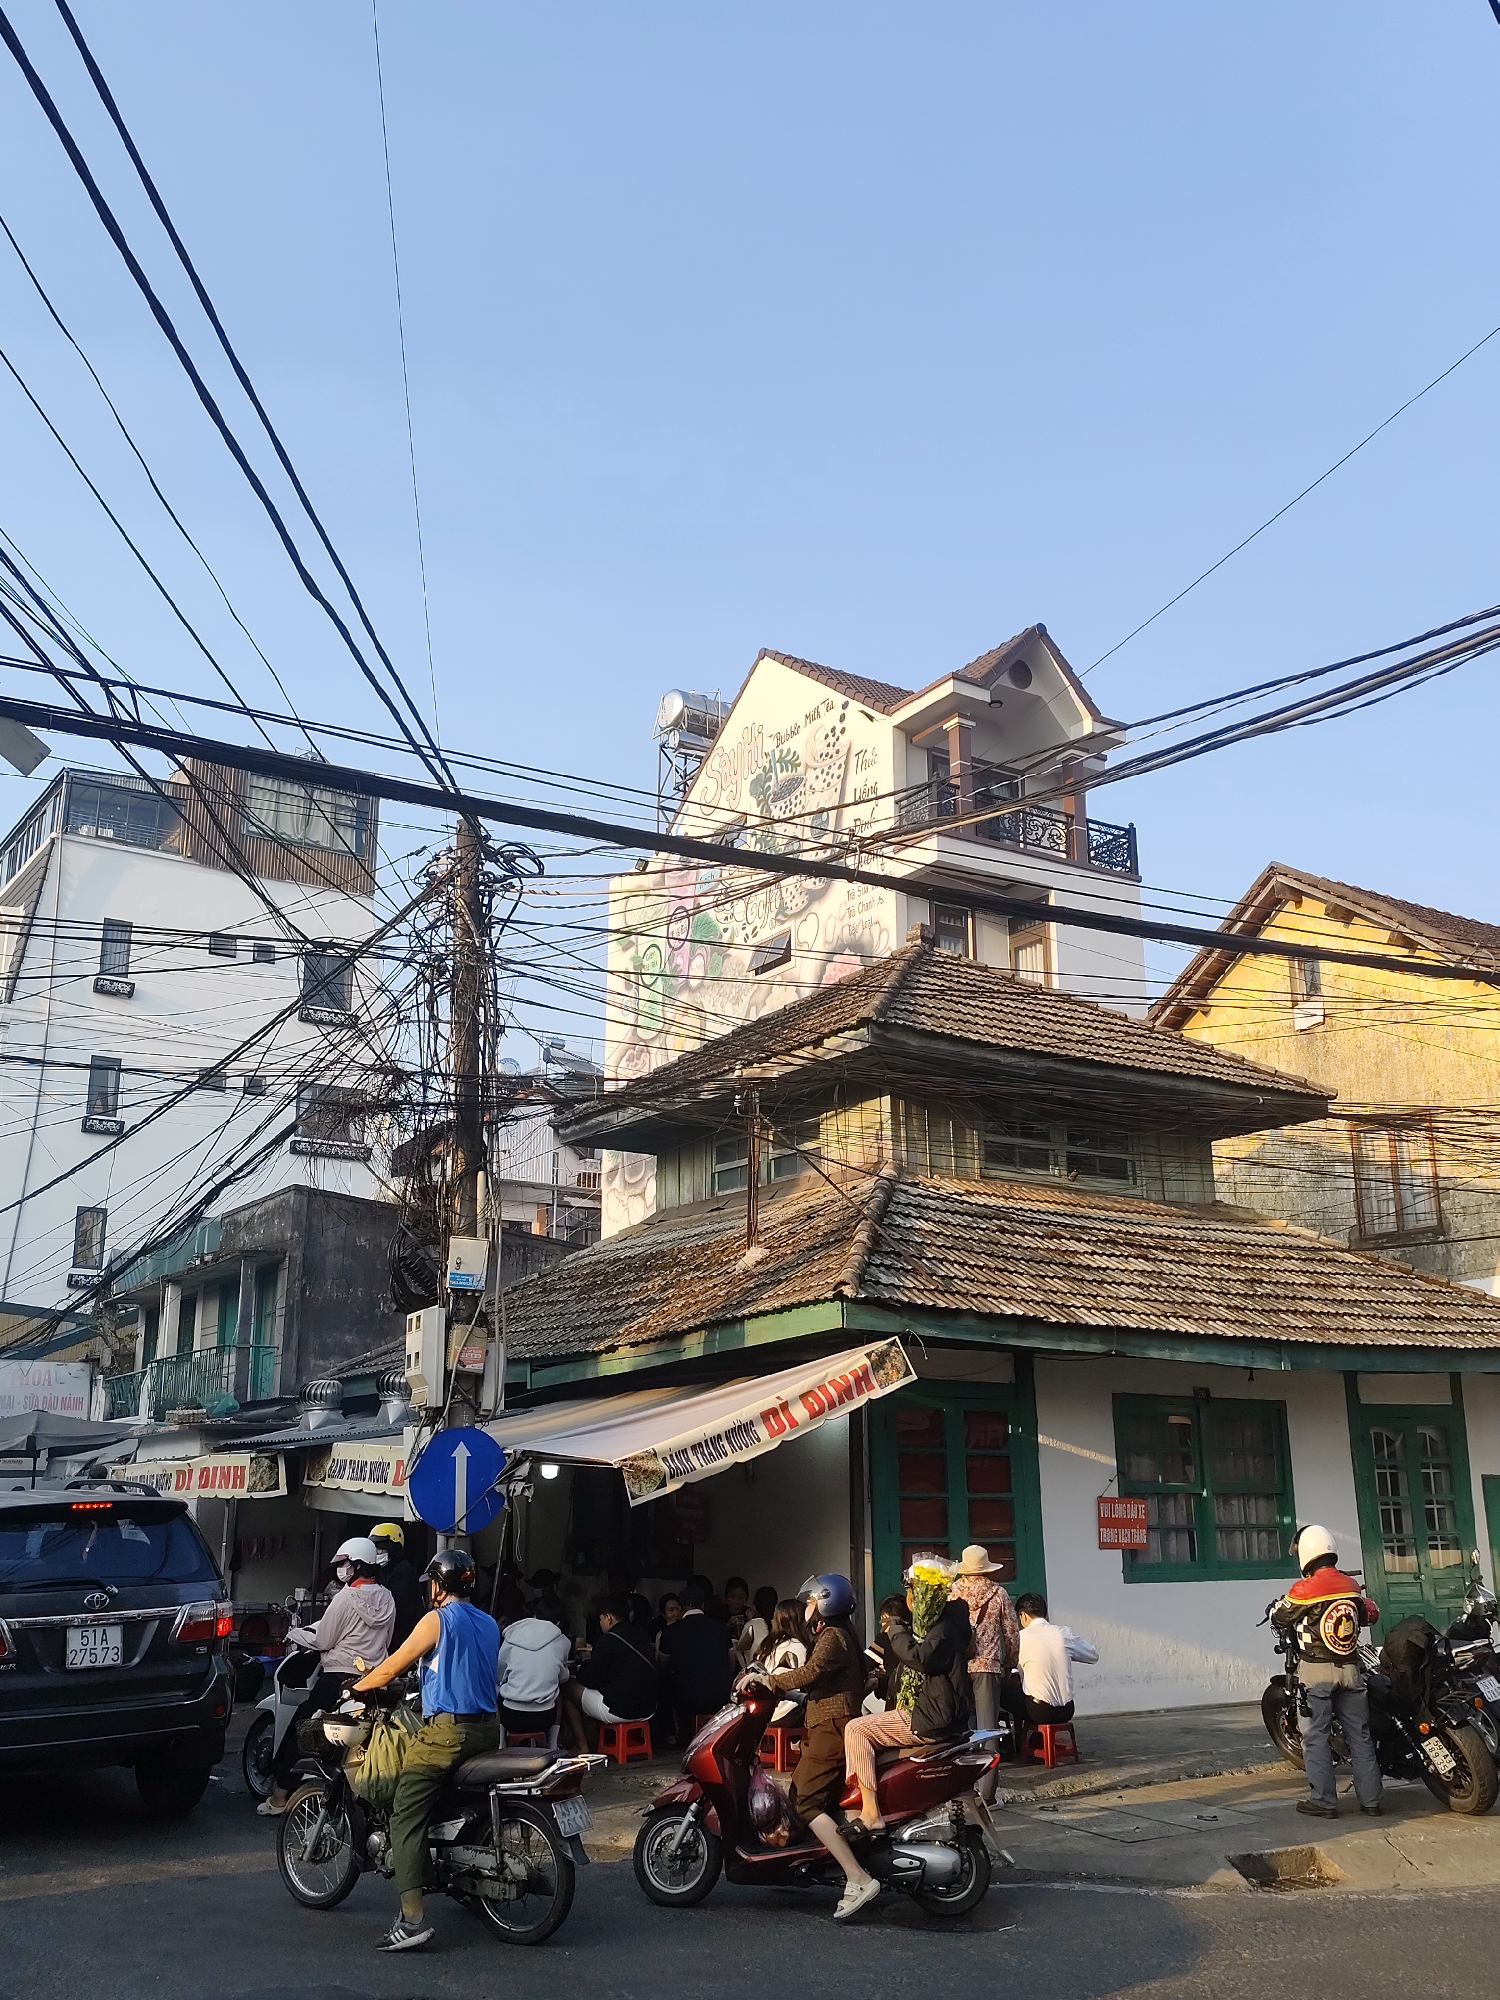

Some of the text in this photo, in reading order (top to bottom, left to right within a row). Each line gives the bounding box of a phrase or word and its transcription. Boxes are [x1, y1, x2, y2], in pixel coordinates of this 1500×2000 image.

[774, 722, 801, 749] Bubble
[60, 1393, 84, 1411] NÀNH
[662, 1447, 698, 1480] BÁNH
[689, 1432, 729, 1468] TRÁNG
[724, 1418, 762, 1454] NƯỚNG
[759, 1395, 800, 1440] DÌ
[174, 1462, 194, 1492] DÌ
[80, 1628, 109, 1647] 51A
[69, 1646, 120, 1666] 275.73
[1433, 1739, 1454, 1765] 59-A3
